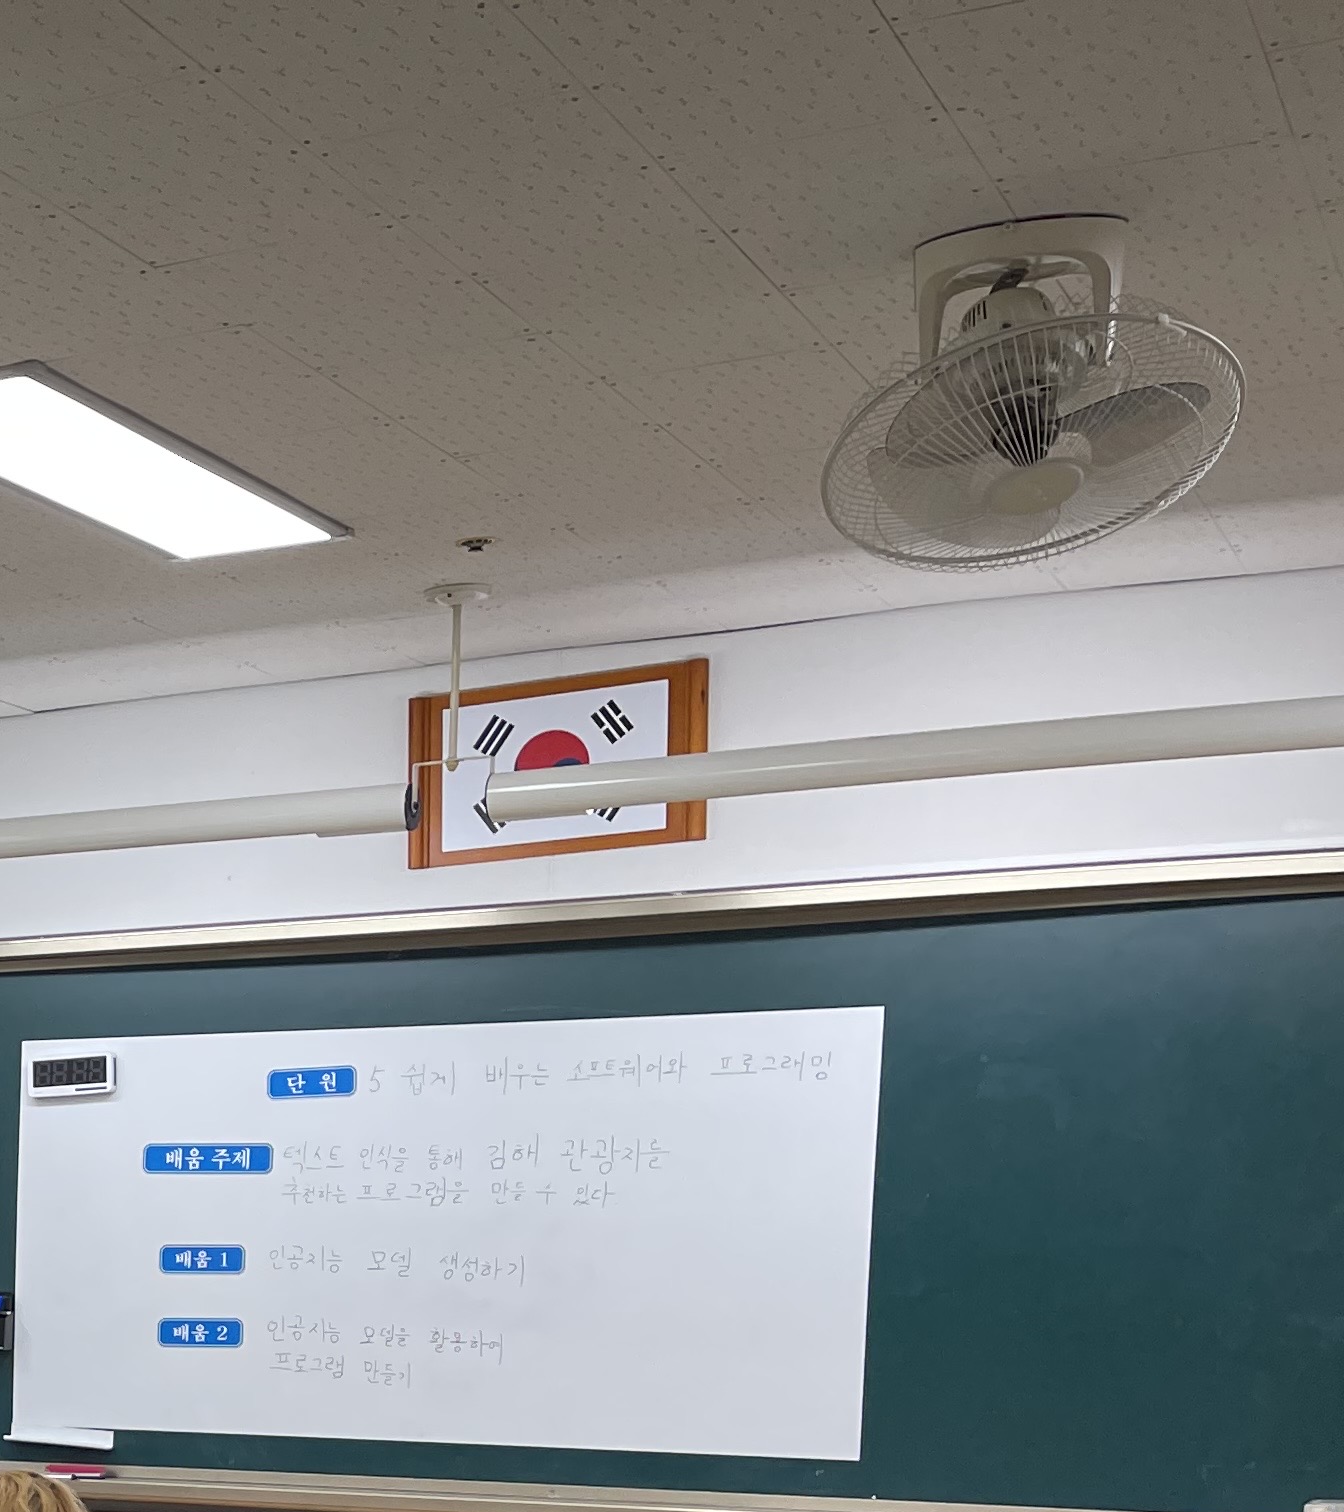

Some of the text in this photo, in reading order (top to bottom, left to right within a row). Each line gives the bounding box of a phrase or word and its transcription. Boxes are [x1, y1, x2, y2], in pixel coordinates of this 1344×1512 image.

[369, 1050, 832, 1096] 5 쉽게 배우는 소프트웨어와 프로그래밍
[165, 1147, 251, 1170] 배움 주제
[283, 1132, 670, 1175] 텍스트 인식을 통해 김해 관광지를
[281, 1176, 347, 1206] 추천하는
[356, 1177, 469, 1207] 프로그램을
[491, 1178, 526, 1205] 만들
[535, 1182, 556, 1205] 수
[175, 1249, 229, 1270] 배움 1
[269, 1245, 524, 1287] 인공지능 모델 생성하기
[172, 1323, 229, 1343] 배움 2
[267, 1315, 503, 1366] 인공지능 모델을 활용하여
[269, 1352, 410, 1388] 프로그램 만들기
